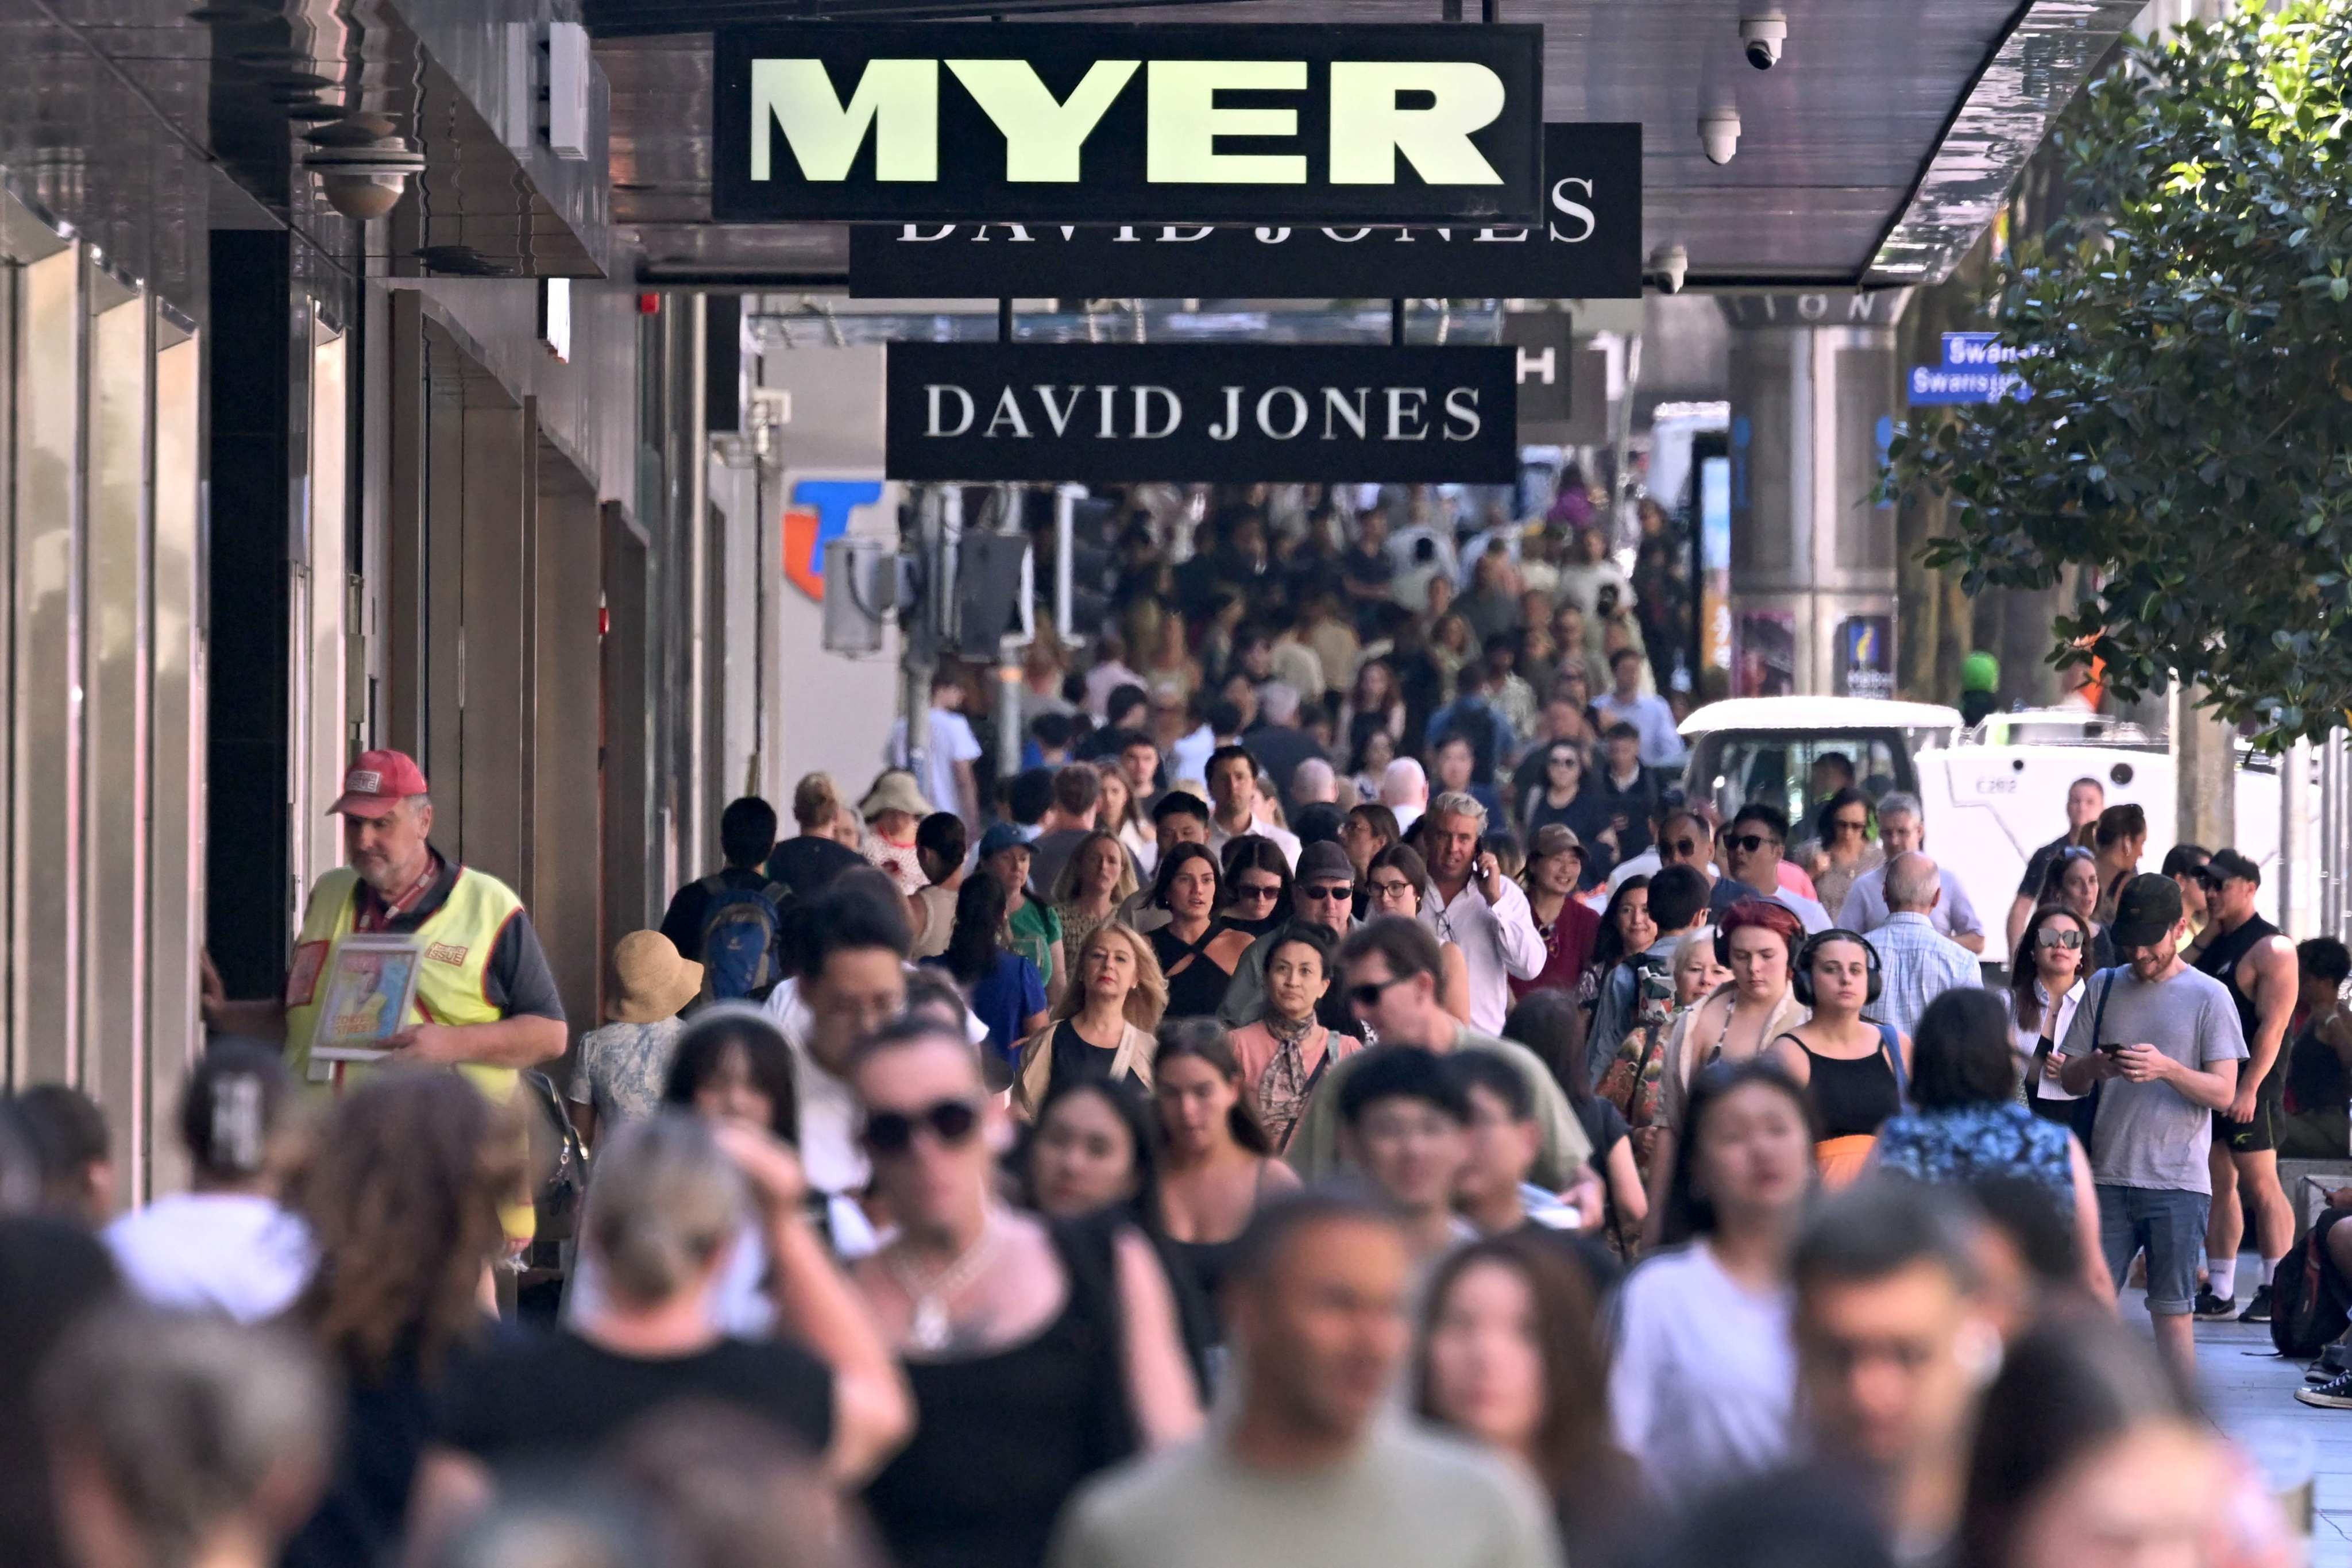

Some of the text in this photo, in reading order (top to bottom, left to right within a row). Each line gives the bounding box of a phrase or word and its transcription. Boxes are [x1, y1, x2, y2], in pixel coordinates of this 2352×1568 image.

[750, 58, 1506, 186] MYER
[1949, 336, 2056, 364] Swan
[922, 384, 1482, 442] DAVID JONES
